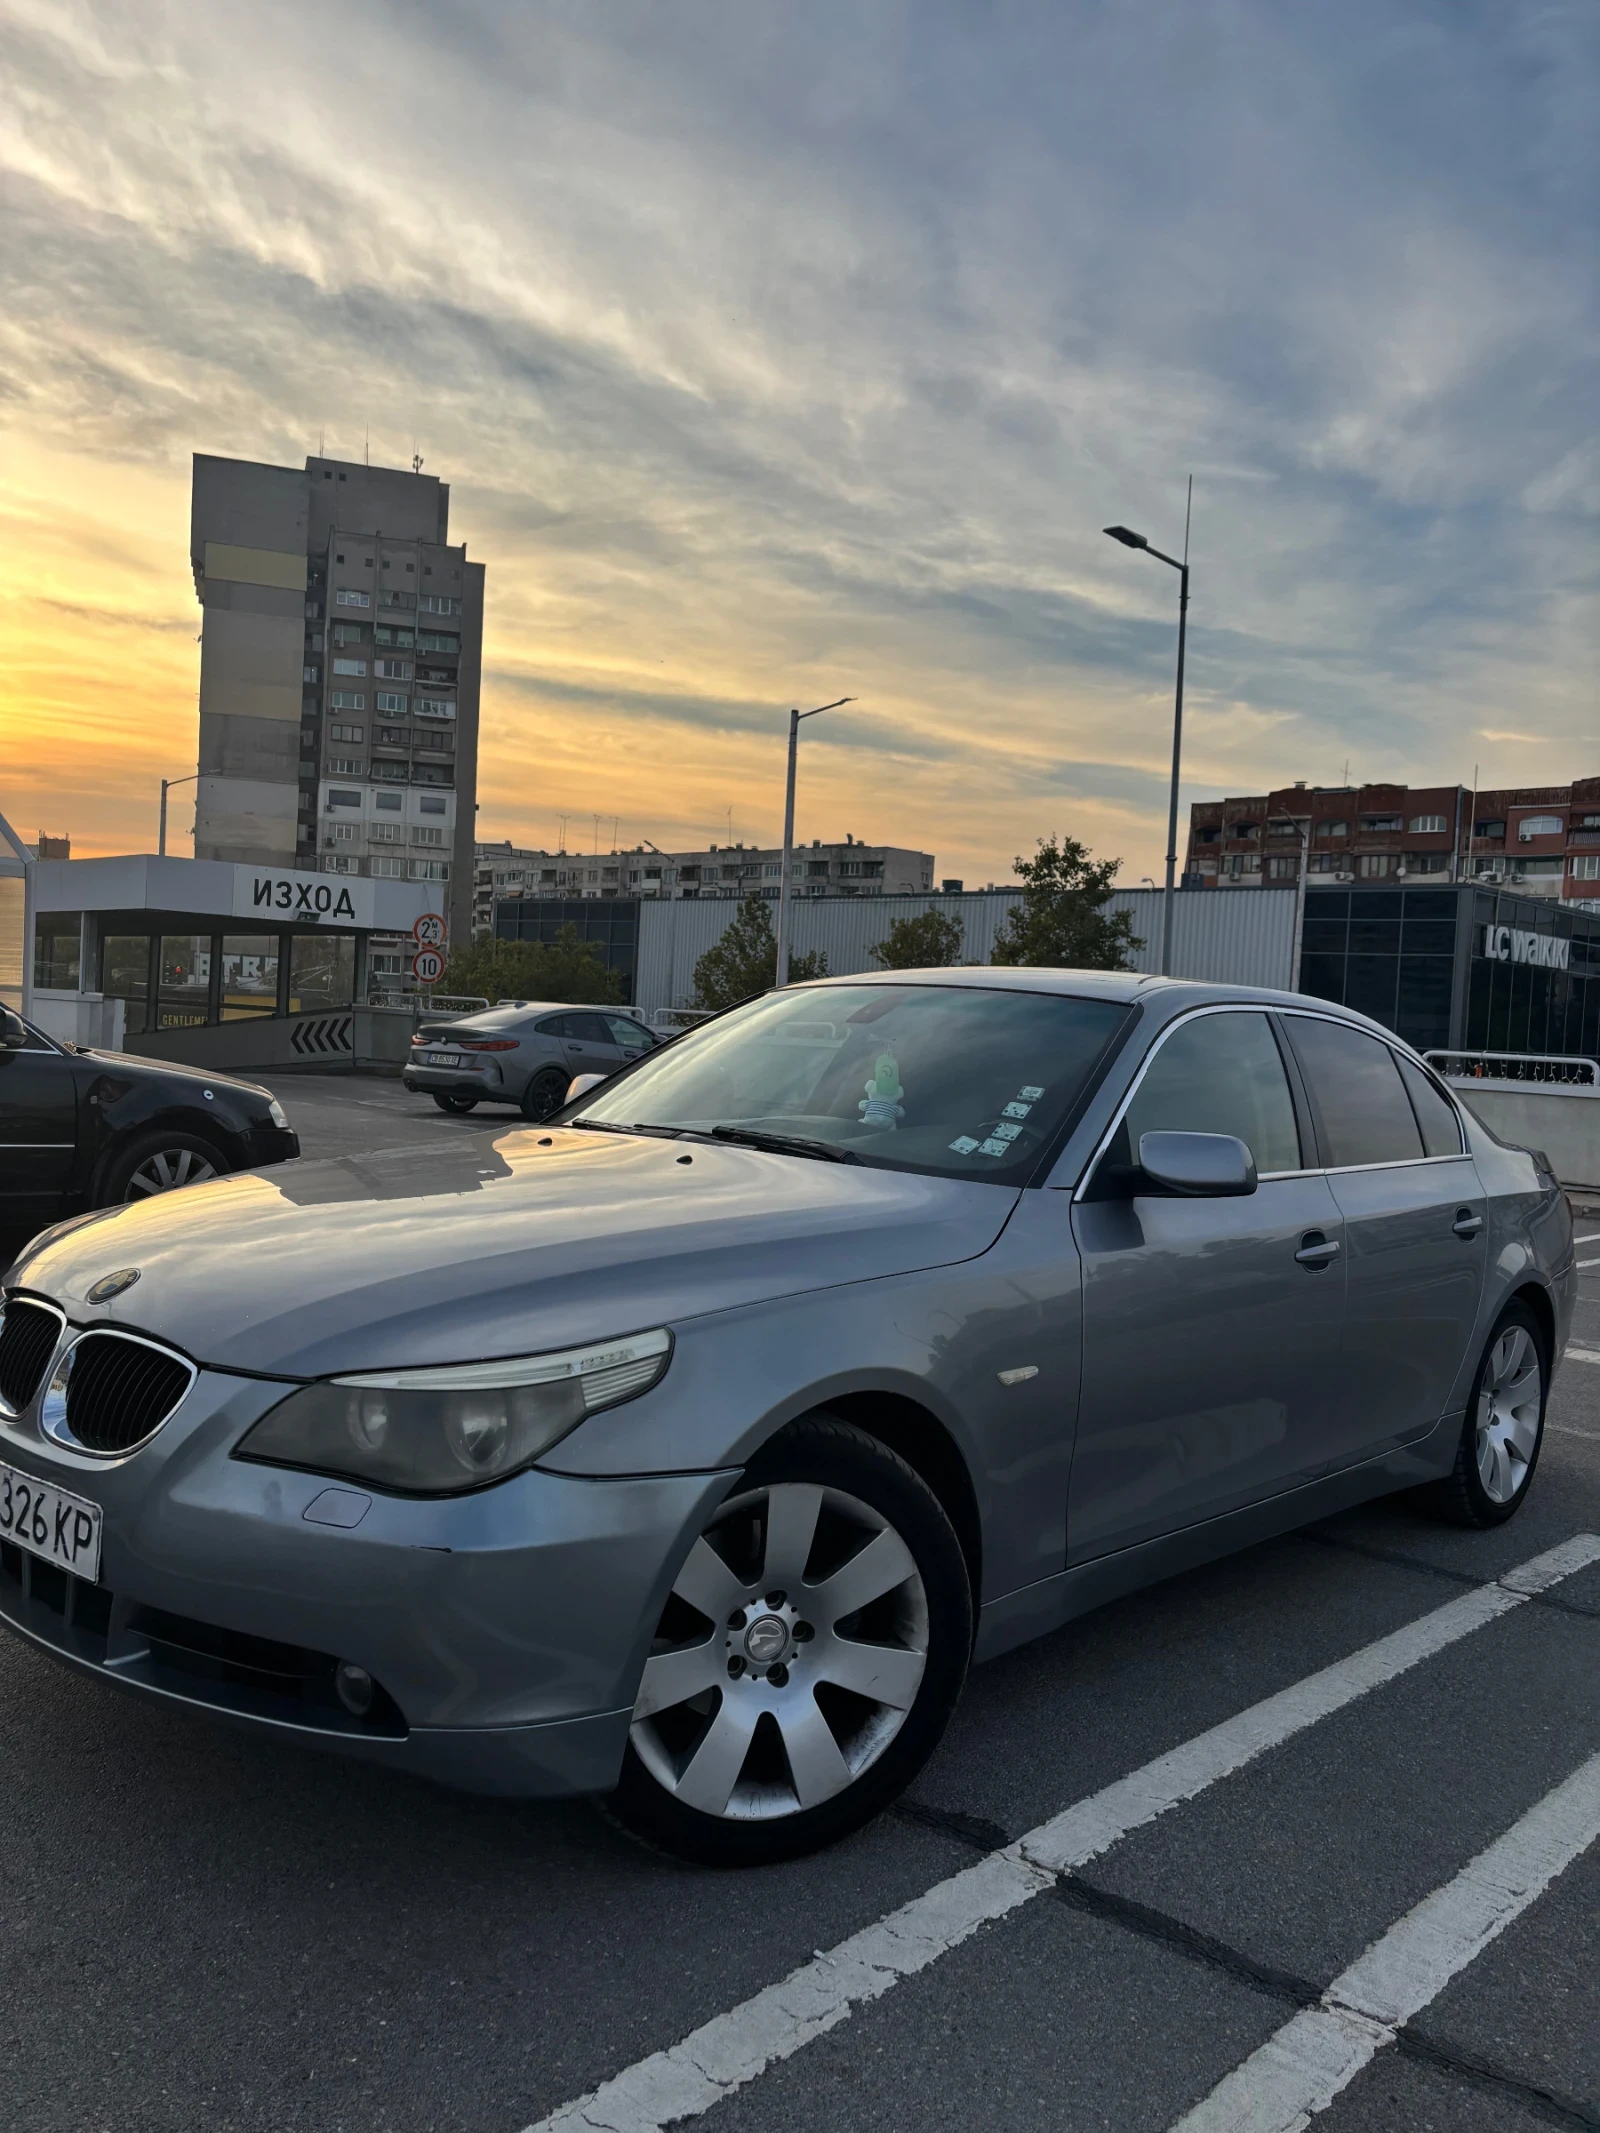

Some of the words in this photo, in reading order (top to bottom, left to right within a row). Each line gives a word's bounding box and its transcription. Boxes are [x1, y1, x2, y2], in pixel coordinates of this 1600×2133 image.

[253, 878, 355, 920] ИЗХОД
[1485, 924, 1510, 960] LC
[422, 958, 437, 976] 10
[53, 1500, 93, 1563] KP
